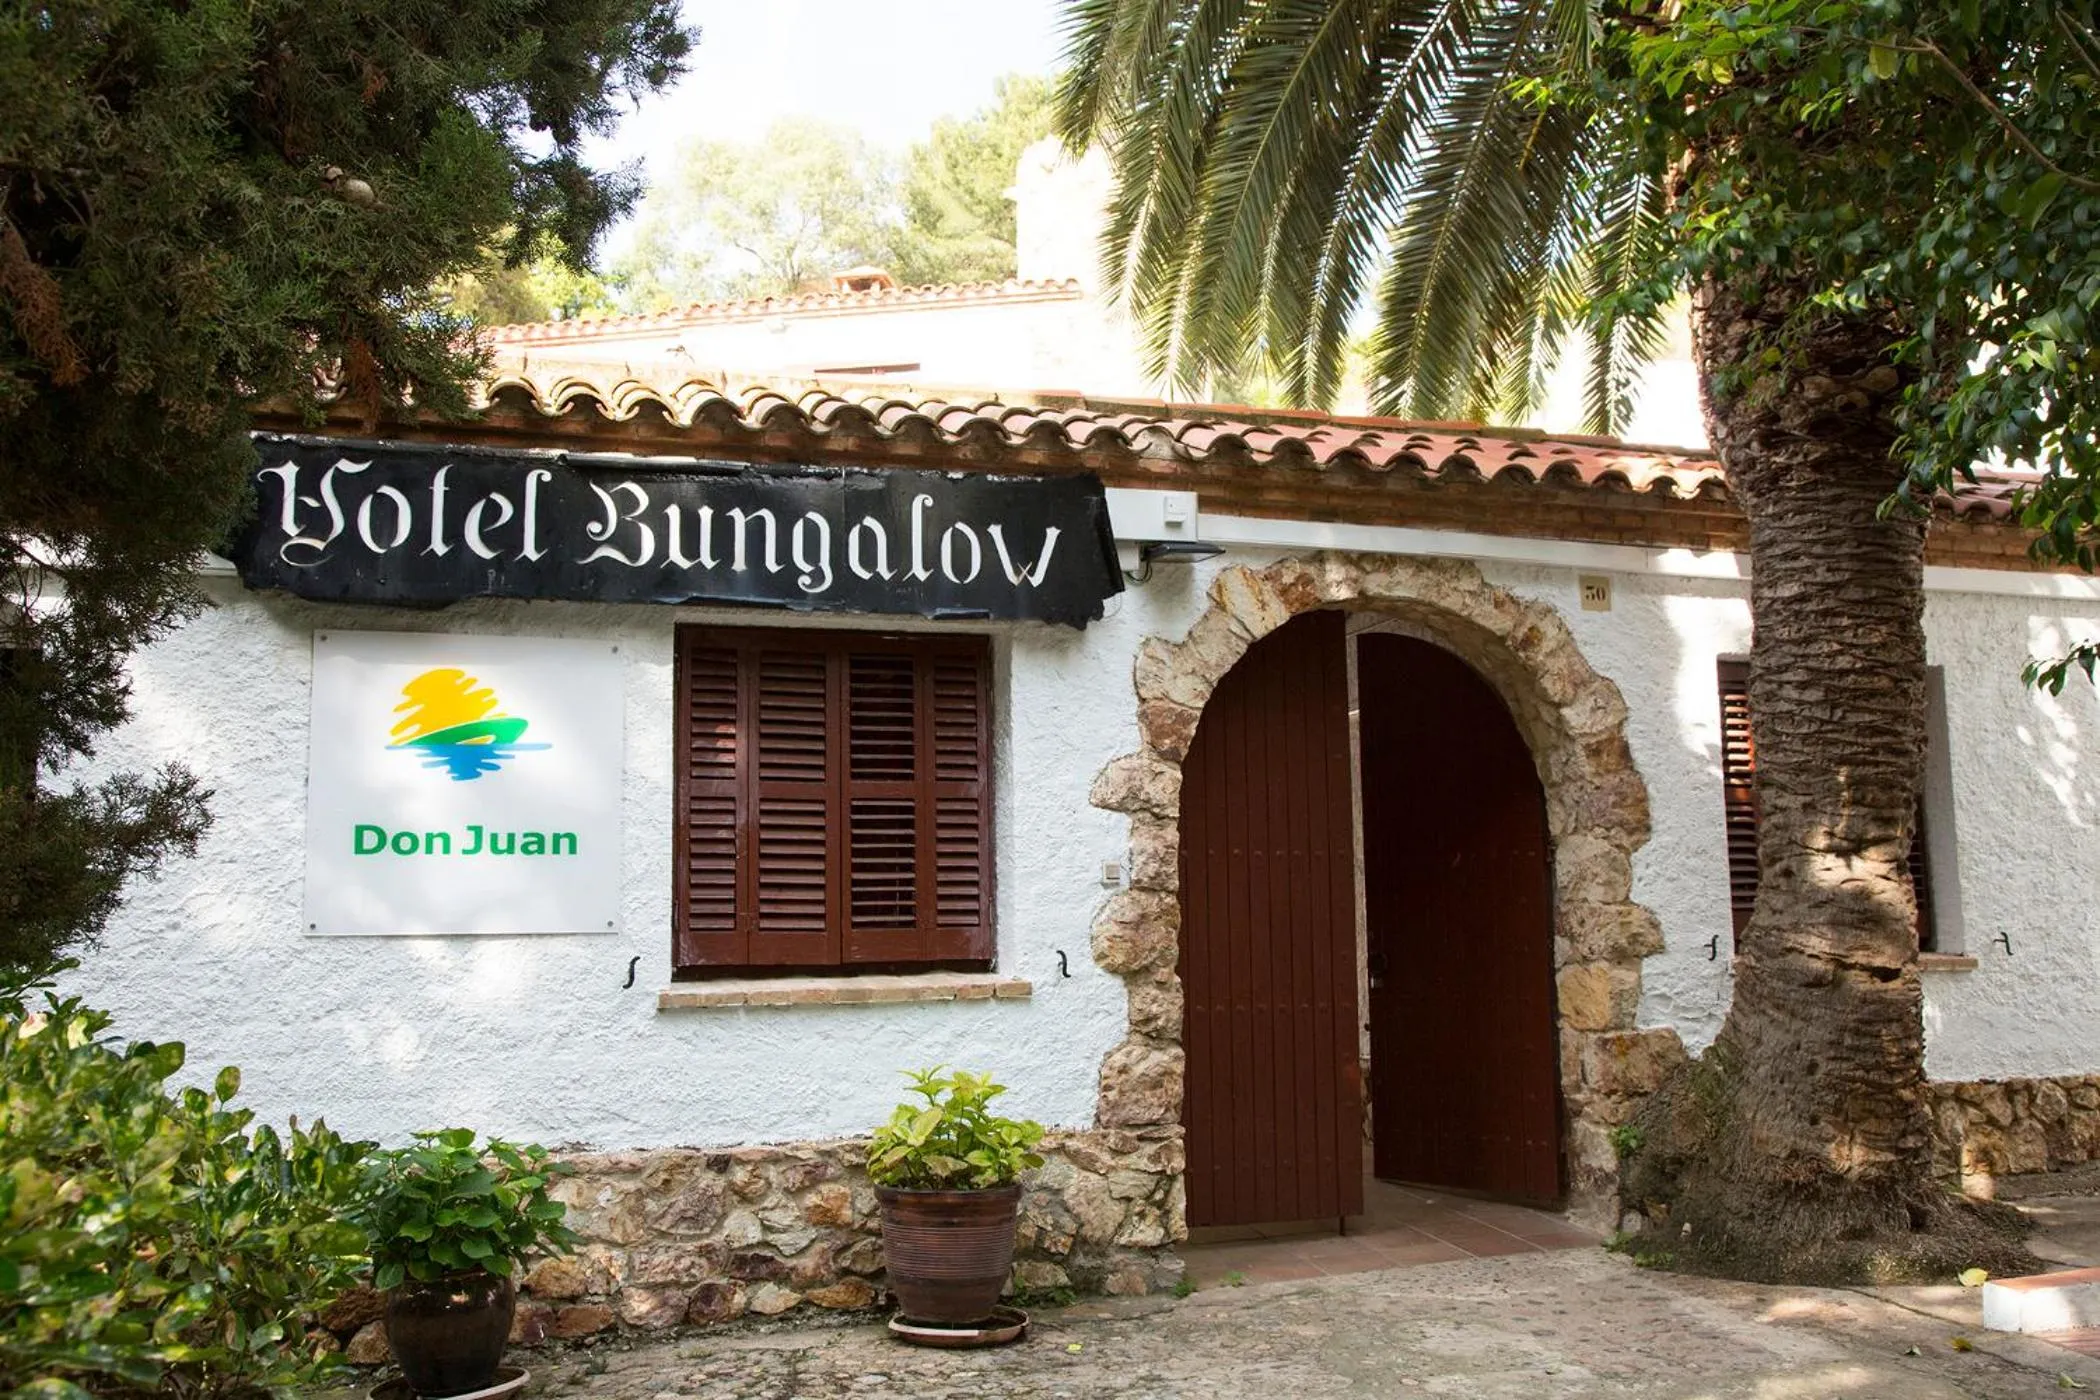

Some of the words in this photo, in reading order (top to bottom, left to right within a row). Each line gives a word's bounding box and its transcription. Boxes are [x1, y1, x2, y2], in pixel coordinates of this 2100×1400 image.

[258, 458, 554, 567] Hotel
[578, 481, 1062, 595] Bungalow
[353, 824, 451, 857] Don
[461, 824, 579, 857] Juan
